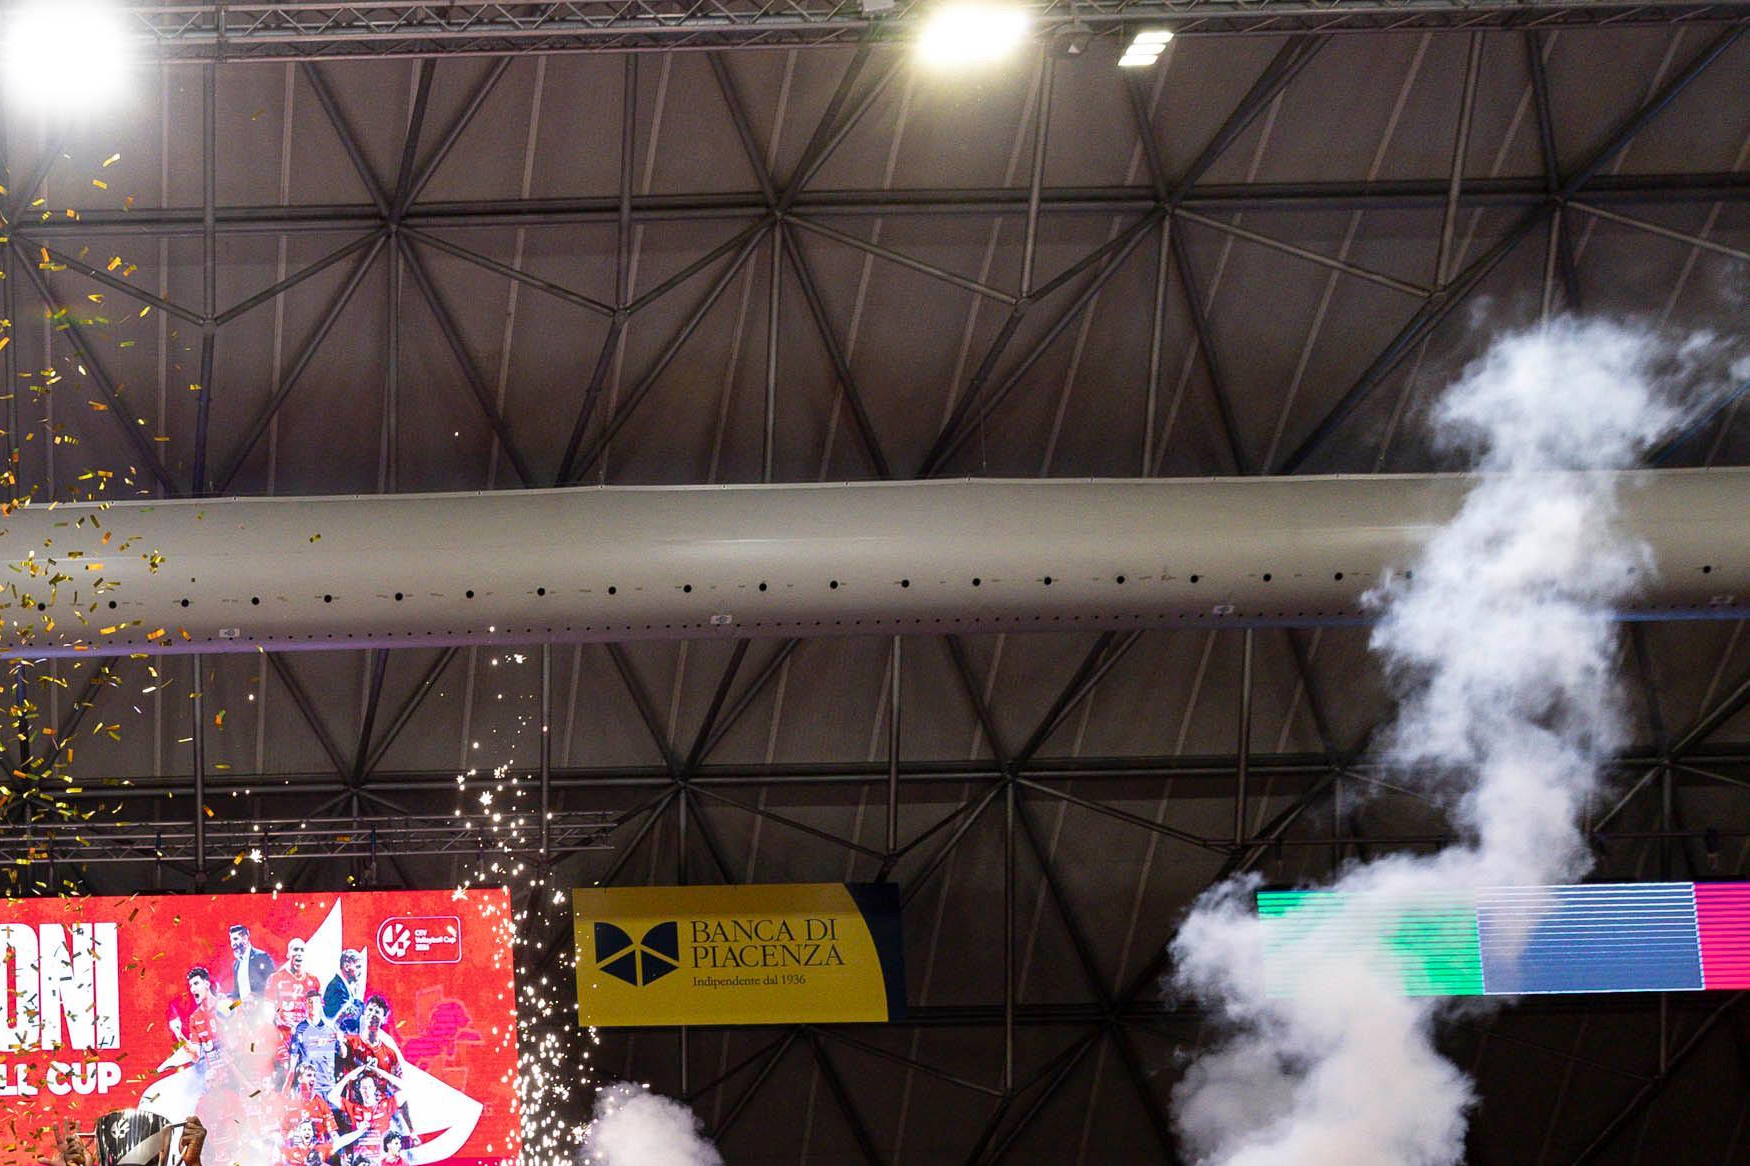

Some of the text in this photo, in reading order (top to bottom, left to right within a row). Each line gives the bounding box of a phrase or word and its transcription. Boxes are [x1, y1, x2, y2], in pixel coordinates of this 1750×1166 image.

[691, 918, 839, 944] BANCA DI
[691, 943, 845, 969] PIACENZA
[693, 974, 806, 989] Indipendente dal 1936
[46, 1061, 122, 1095] CUP
